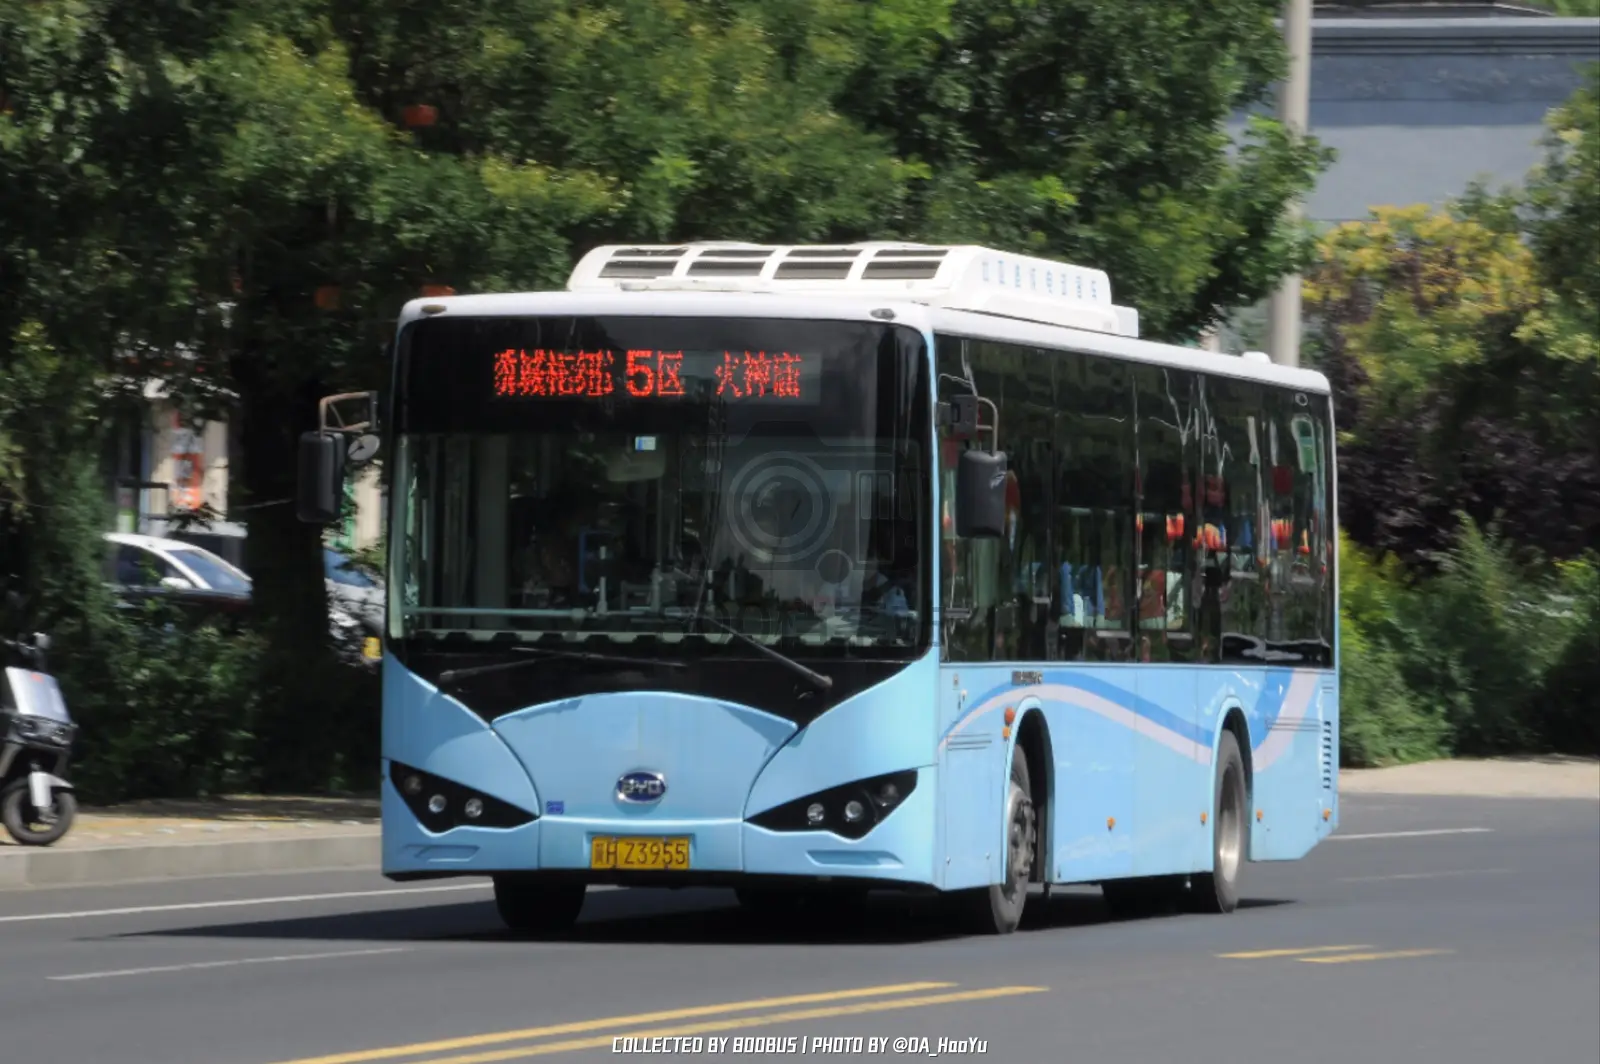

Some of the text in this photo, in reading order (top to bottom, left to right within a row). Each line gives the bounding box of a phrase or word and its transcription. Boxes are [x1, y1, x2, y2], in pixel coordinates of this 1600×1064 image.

[713, 350, 803, 398] 火神庙
[621, 778, 663, 797] BYD
